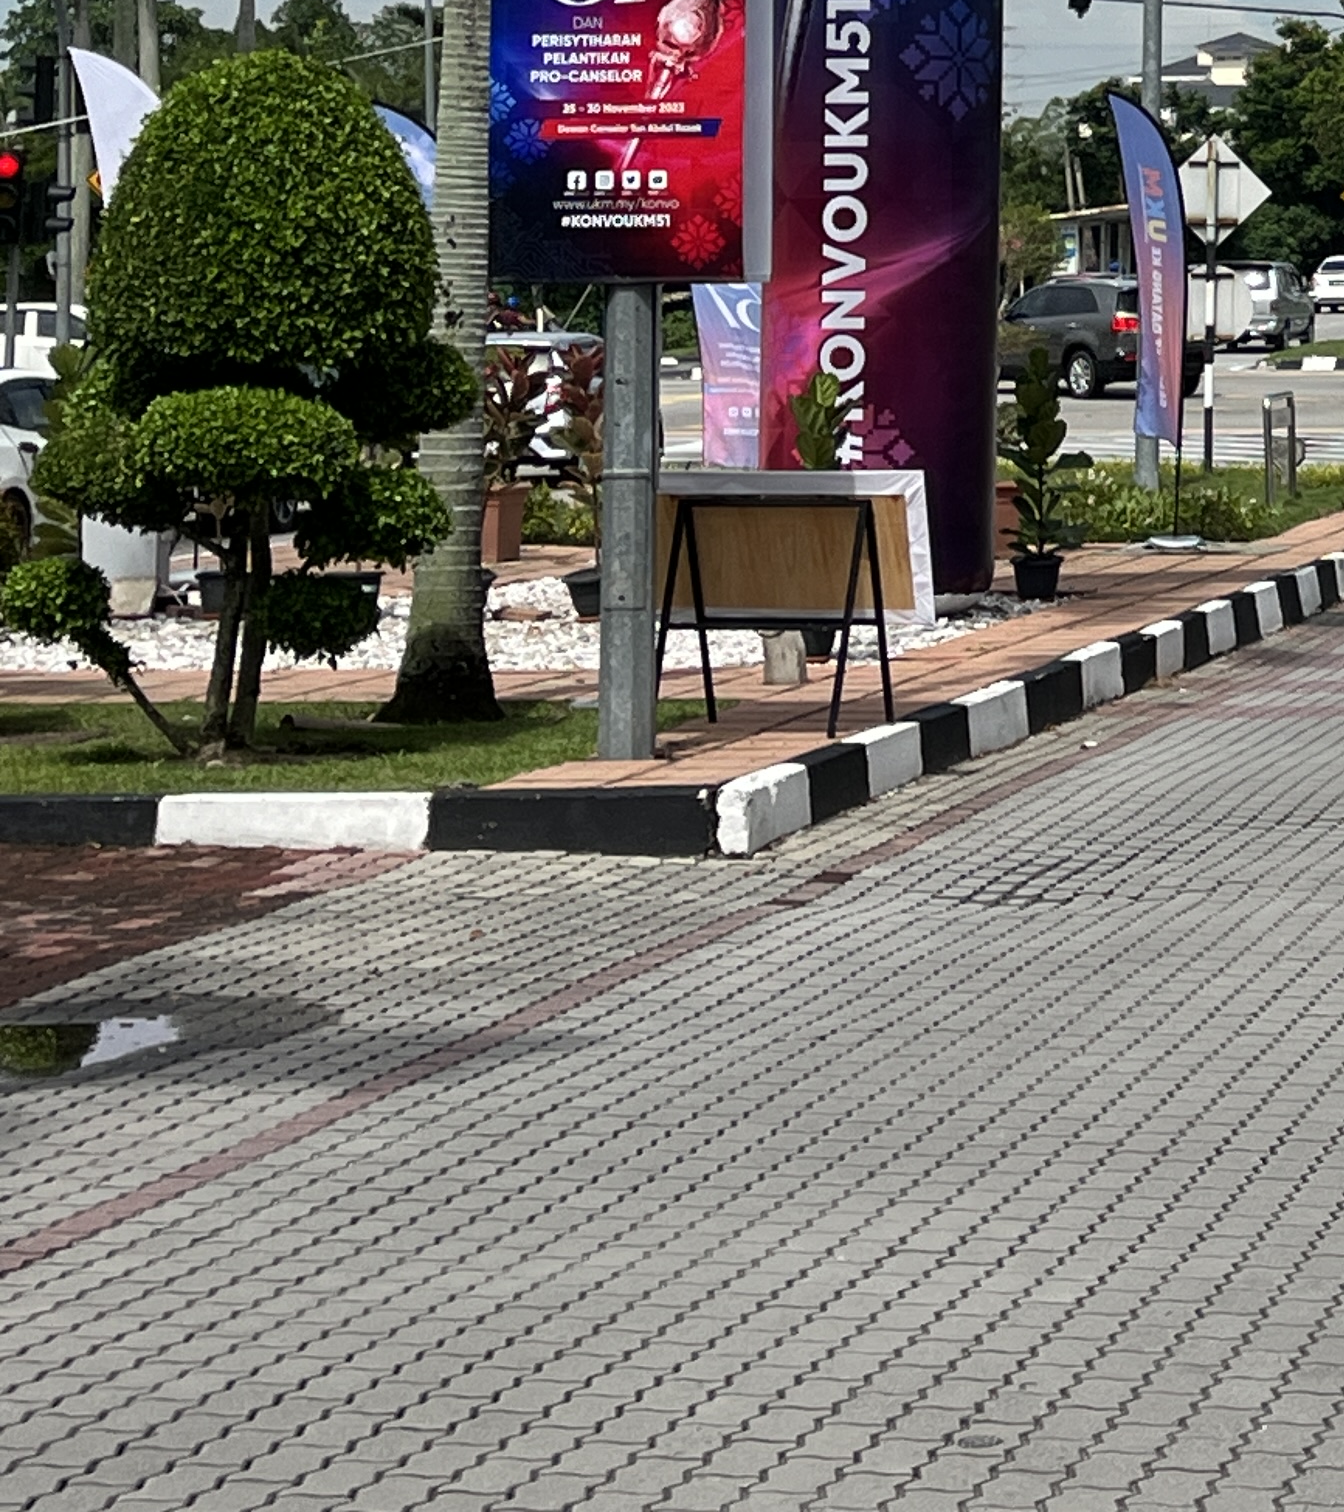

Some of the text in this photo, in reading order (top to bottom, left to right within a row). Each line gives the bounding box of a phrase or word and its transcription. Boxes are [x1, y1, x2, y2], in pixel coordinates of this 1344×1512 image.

[572, 16, 604, 30] DAN
[531, 33, 642, 48] PERISYTIHARAN
[543, 51, 631, 65] PELANTIKAN
[530, 69, 643, 83] PRO-CANSELOR
[602, 102, 657, 114] November
[552, 196, 680, 212] www.ukm.my/konvo
[560, 213, 671, 228] #KONVOUKM51
